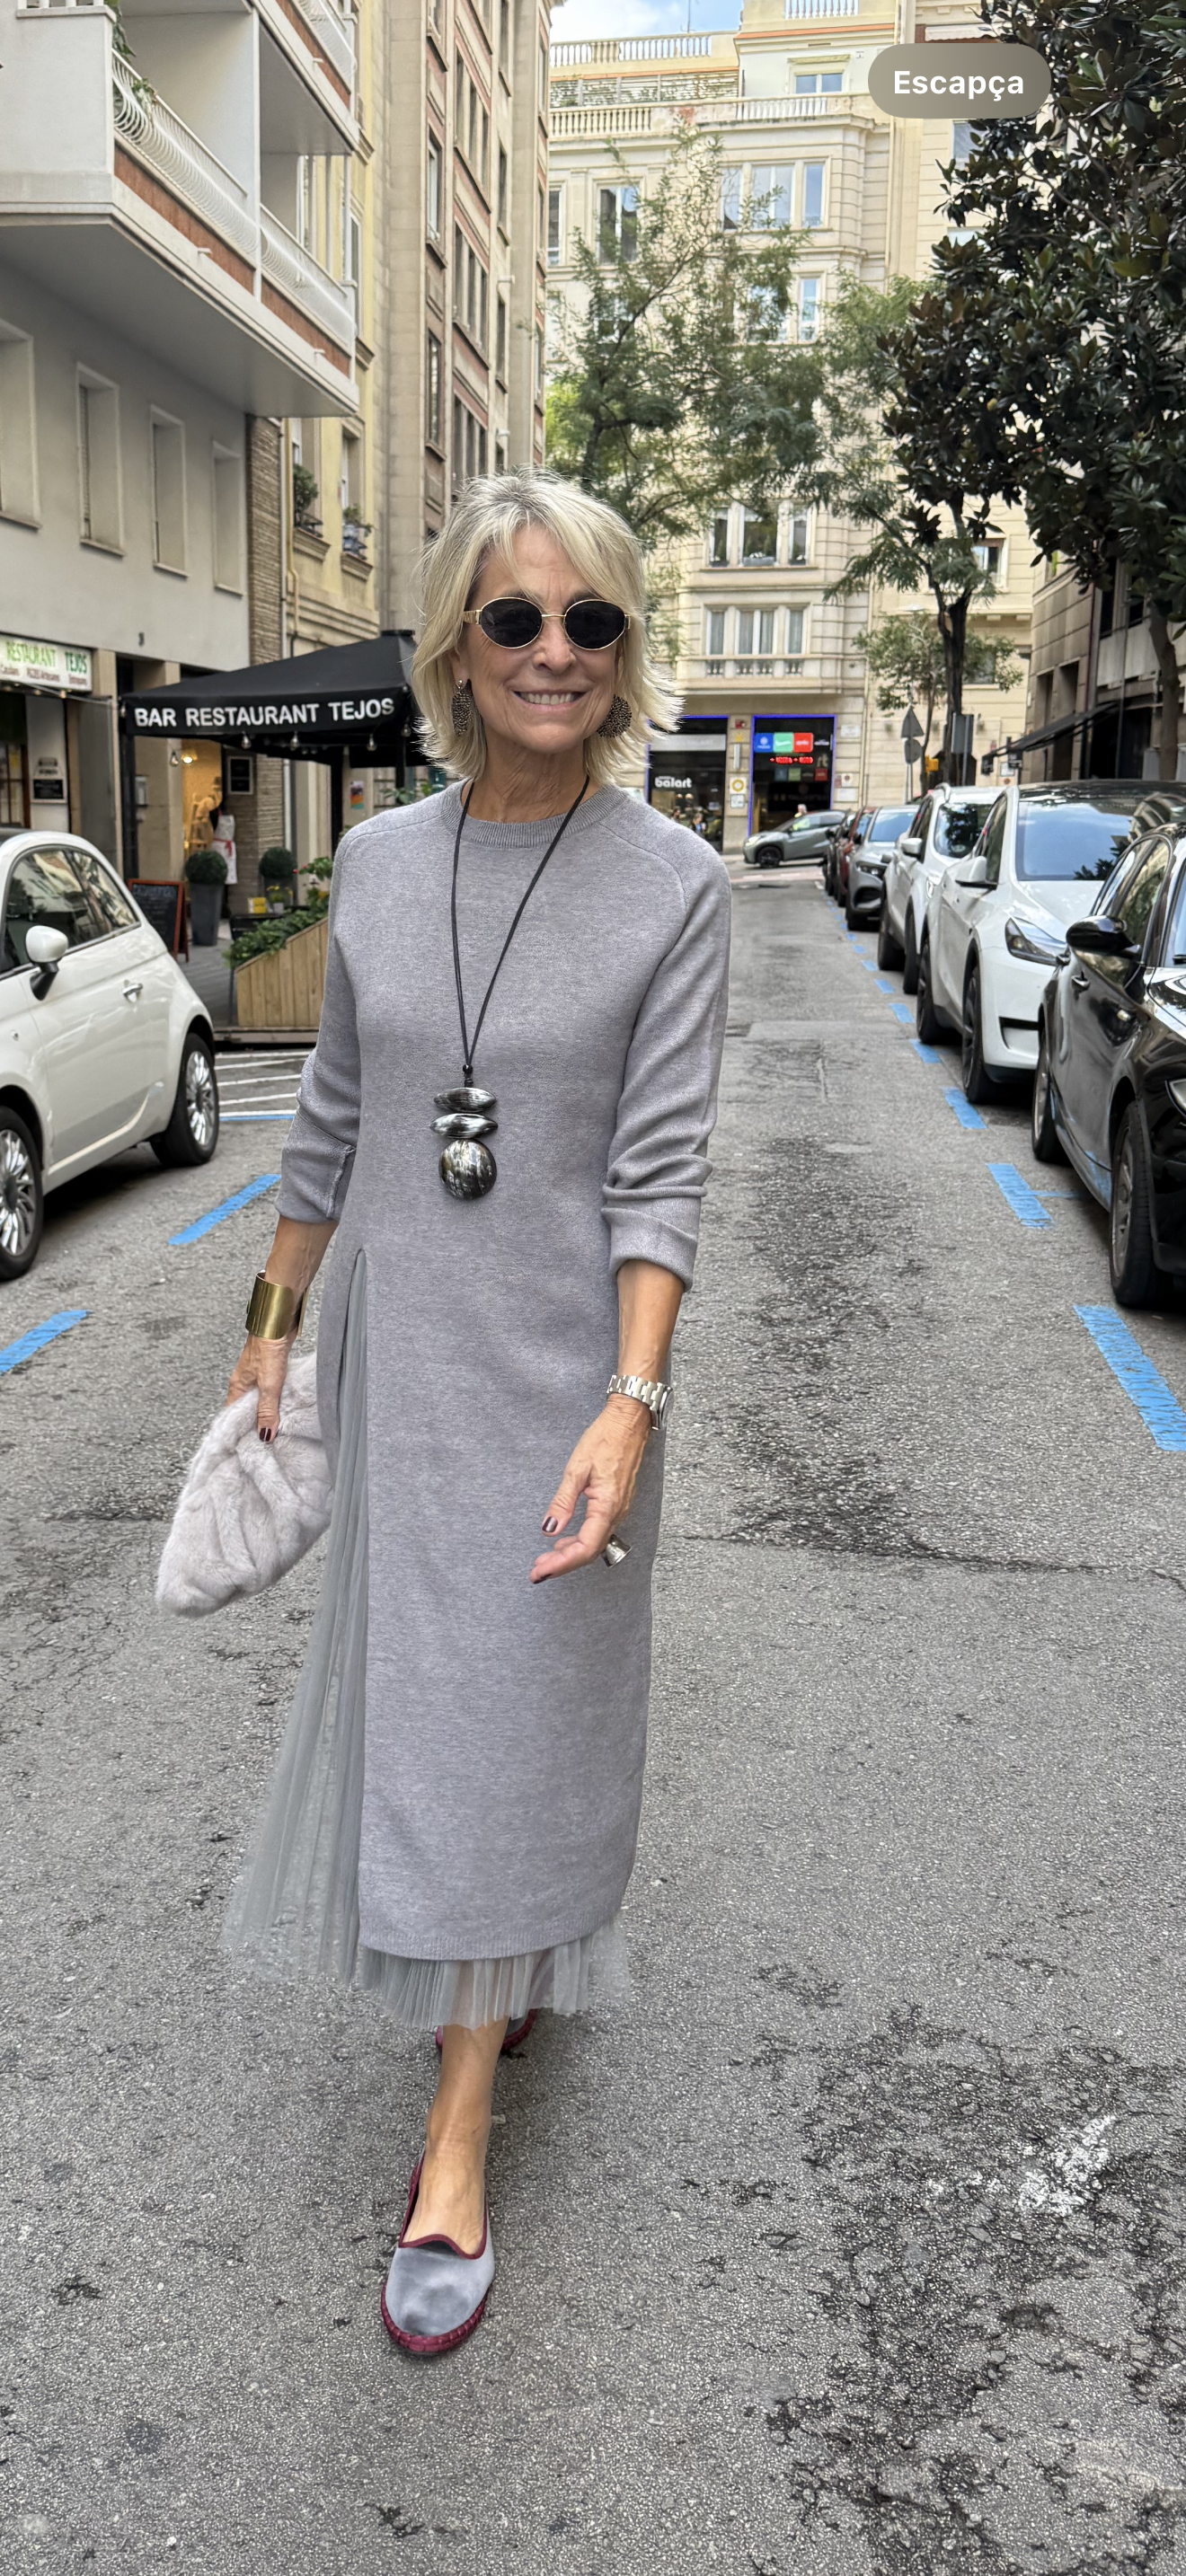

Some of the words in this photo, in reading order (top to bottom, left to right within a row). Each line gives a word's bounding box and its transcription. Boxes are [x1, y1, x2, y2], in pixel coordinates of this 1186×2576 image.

[5, 640, 56, 666] RESTAURANT
[65, 652, 87, 674] TEJOS
[134, 708, 176, 727] BAR
[185, 703, 320, 726] RESTAURANT
[328, 698, 394, 721] TEJOS
[655, 777, 692, 788] balart
